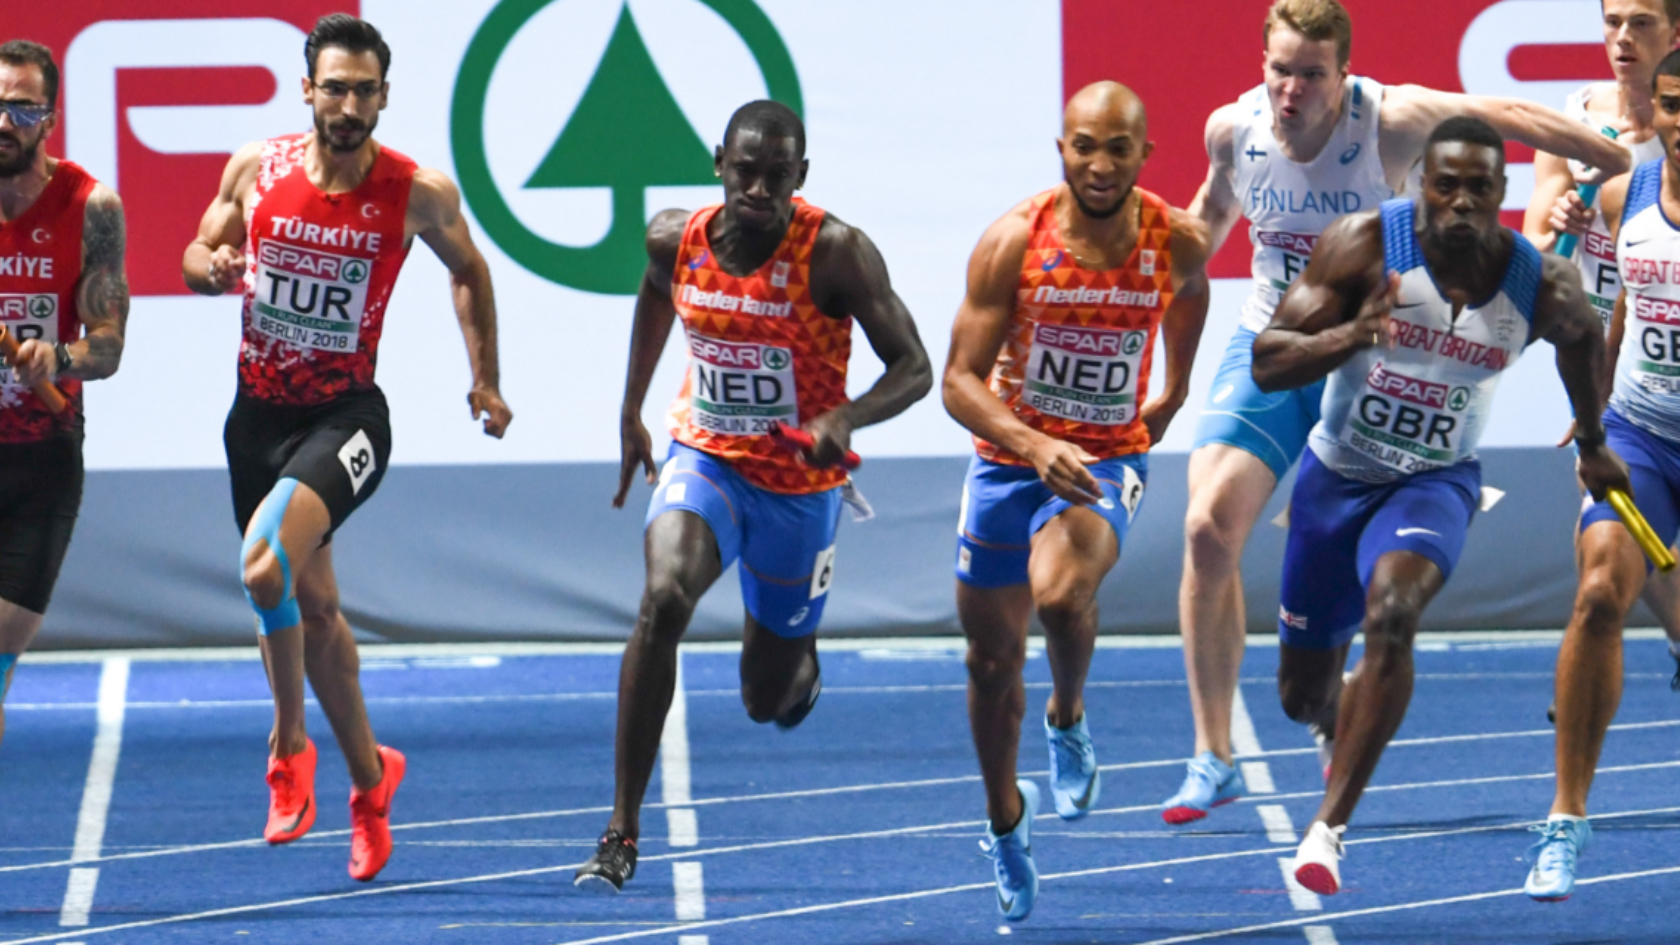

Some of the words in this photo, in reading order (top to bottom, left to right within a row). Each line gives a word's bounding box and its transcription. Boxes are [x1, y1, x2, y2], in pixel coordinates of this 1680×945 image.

[1251, 187, 1361, 214] FINLAND
[271, 215, 382, 252] TÜRKİYE
[1261, 232, 1320, 253] SPA
[261, 244, 338, 278] SPAR
[1624, 256, 1671, 284] GREAT
[265, 270, 353, 321] TUR
[260, 316, 309, 344] BERLIN
[312, 332, 349, 349] 2018
[1038, 327, 1120, 354] SPAR
[691, 339, 759, 366] SPAR
[1440, 335, 1511, 372] BRITAIN
[698, 364, 783, 405] NED
[1037, 350, 1131, 395] NED
[1367, 365, 1447, 406] SPAR
[699, 411, 747, 432] BERLIN
[1032, 395, 1088, 420] BERLIN
[1091, 405, 1127, 422] 2018
[1359, 394, 1457, 449] GBR
[1351, 432, 1405, 466] BERLIN
